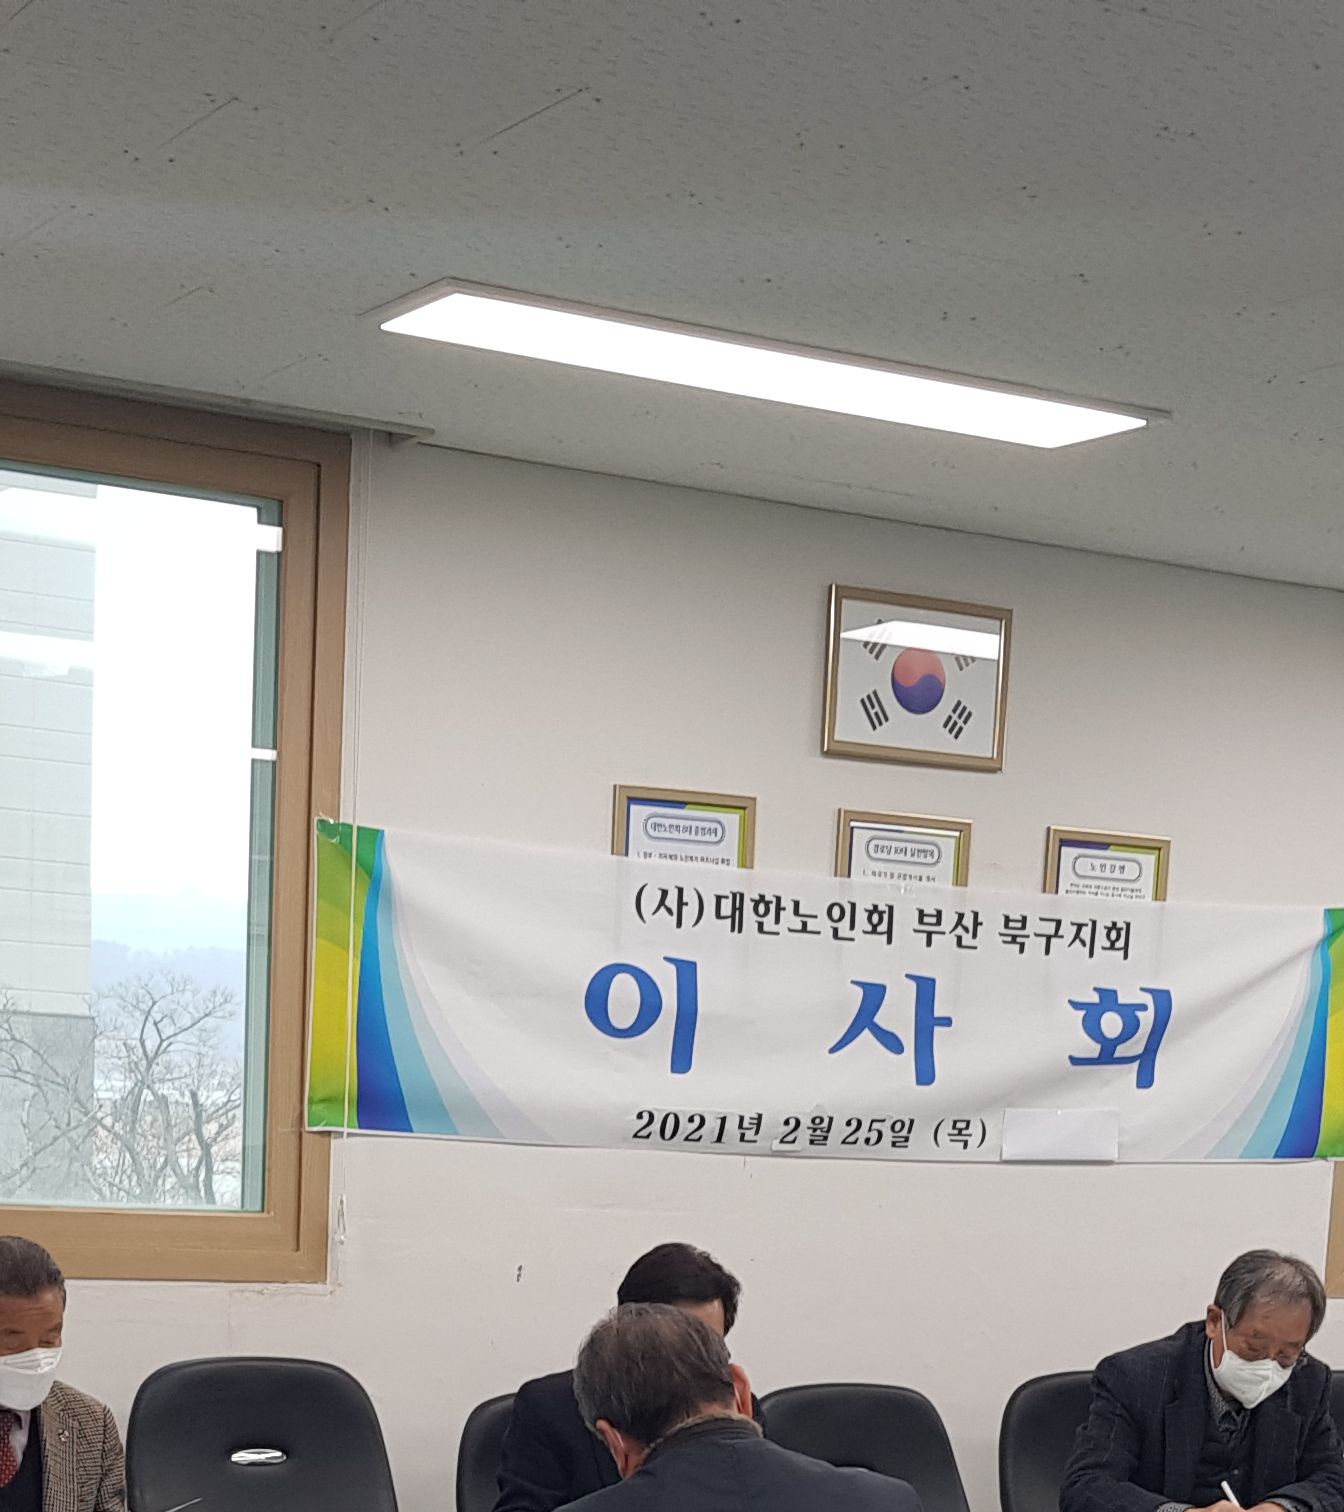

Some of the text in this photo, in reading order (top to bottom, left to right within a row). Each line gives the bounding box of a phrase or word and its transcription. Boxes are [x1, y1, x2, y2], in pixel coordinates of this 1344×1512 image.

[633, 881, 1132, 961] (사)대한노인회 부산 북구지회
[631, 1108, 988, 1151] 2021년 2월 25일 (목)
